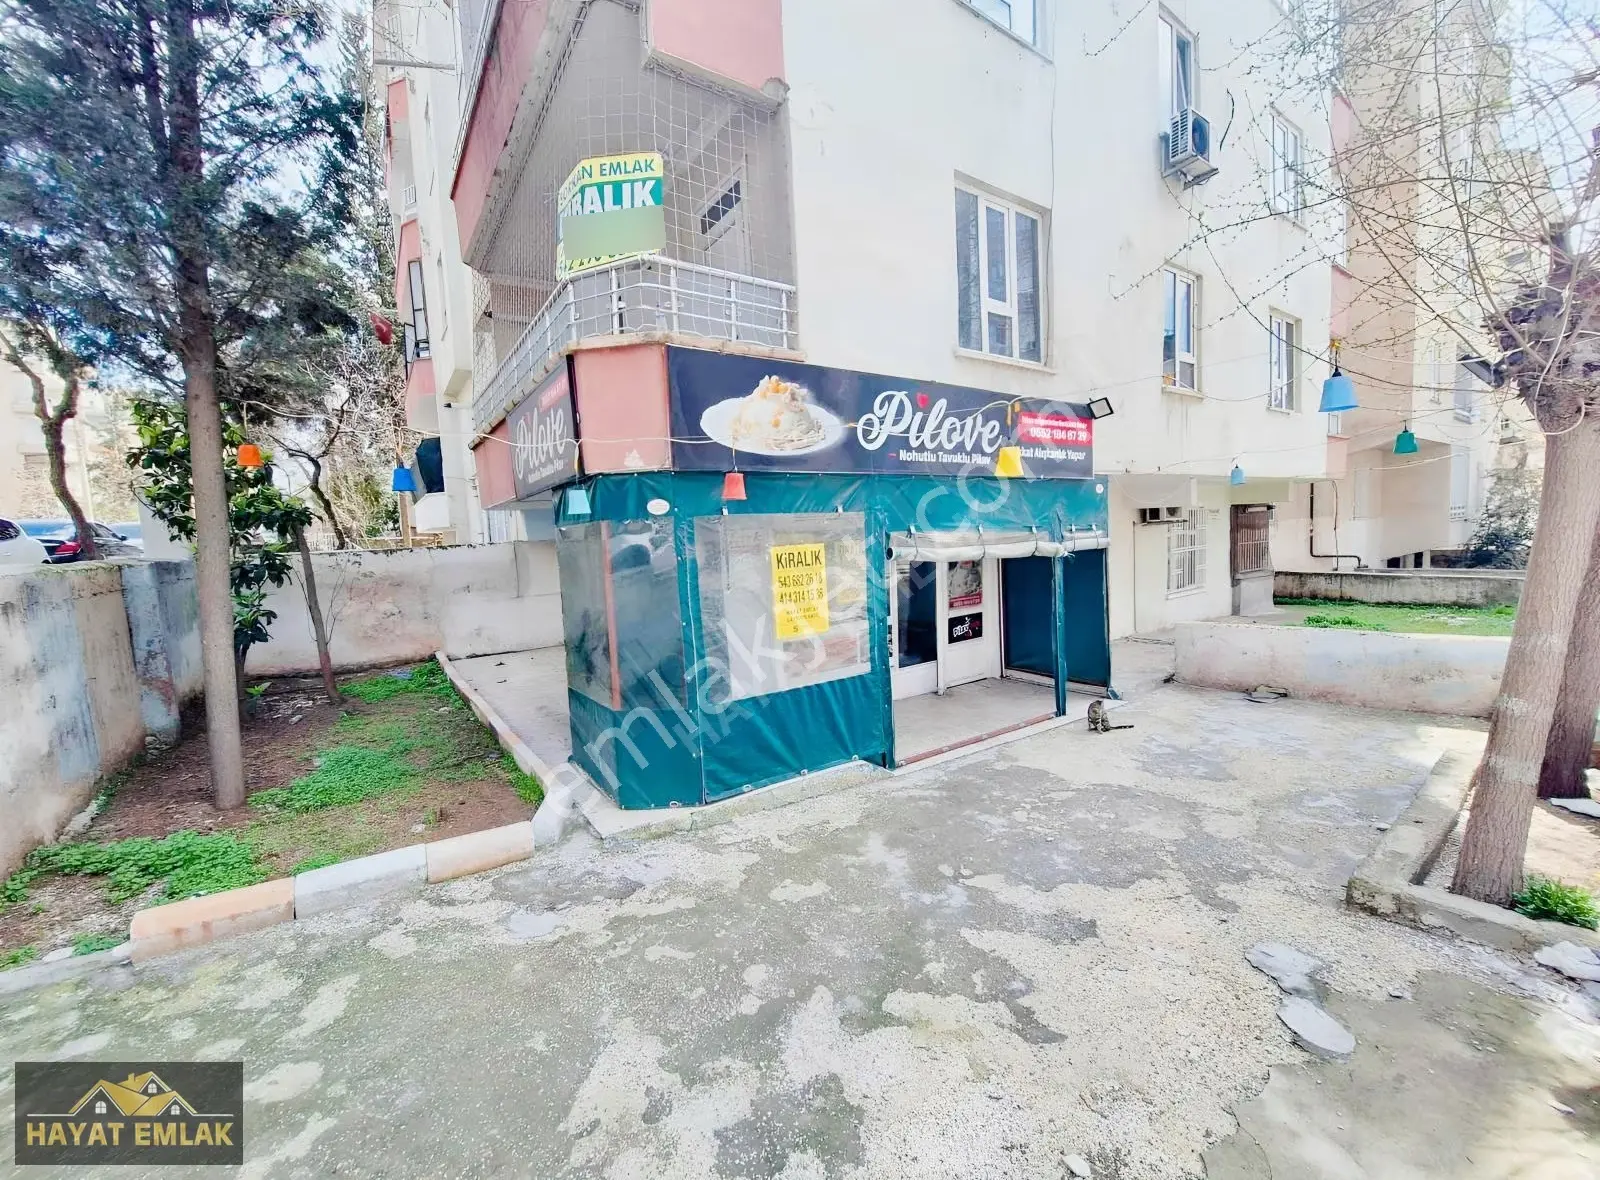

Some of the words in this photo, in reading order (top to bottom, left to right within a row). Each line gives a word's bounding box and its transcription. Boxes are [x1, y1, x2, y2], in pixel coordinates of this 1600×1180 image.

[600, 158, 655, 177] EMLAK
[857, 390, 1003, 453] Pilove
[515, 407, 567, 480] Pilove
[899, 449, 936, 462] Nohutlu
[937, 452, 970, 464] Tavuklu
[971, 453, 992, 465] Pilav
